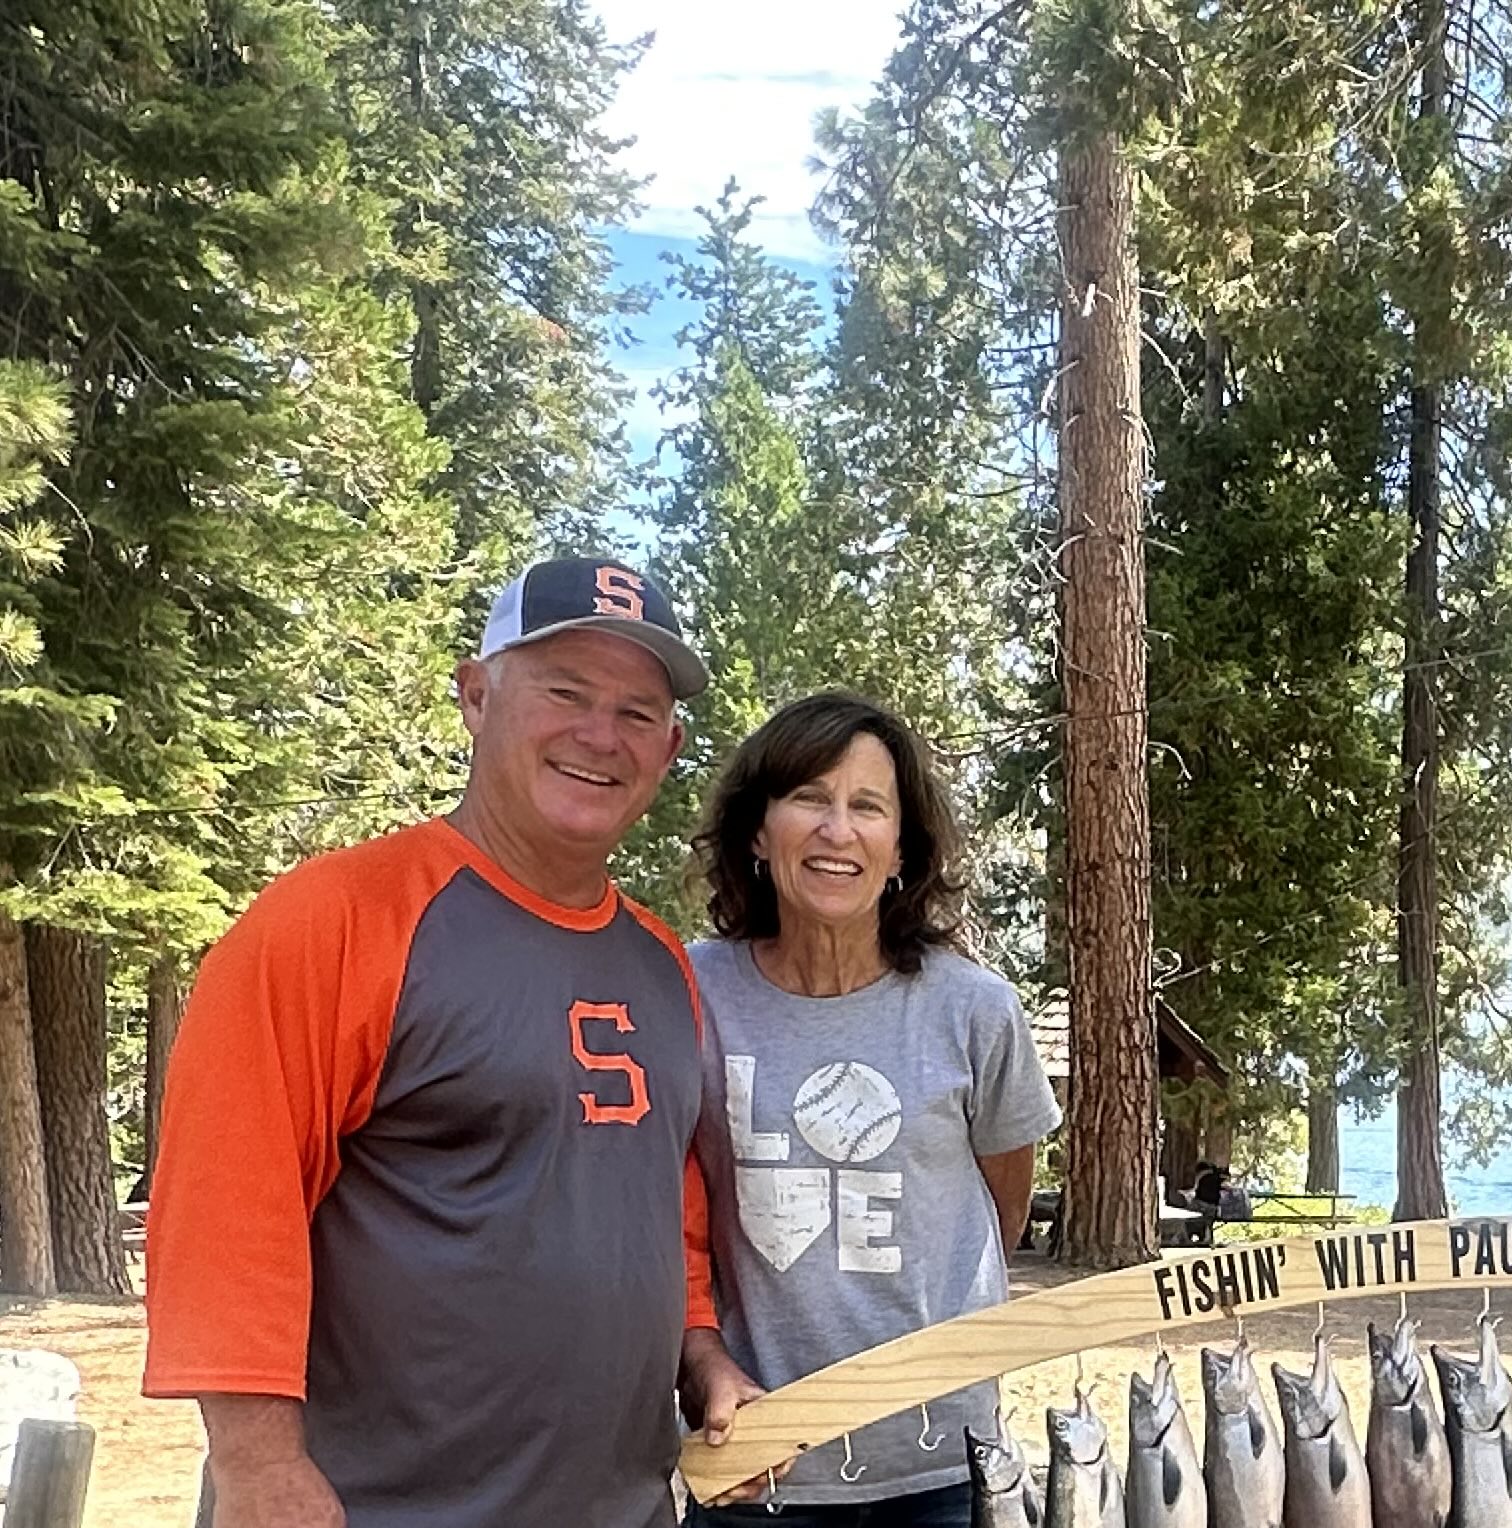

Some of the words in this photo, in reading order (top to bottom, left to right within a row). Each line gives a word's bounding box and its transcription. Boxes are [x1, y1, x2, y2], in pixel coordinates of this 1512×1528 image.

[593, 565, 645, 620] S
[568, 999, 651, 1126] S
[1154, 1244, 1285, 1320] FISHIN'
[1315, 1230, 1416, 1291] WITH
